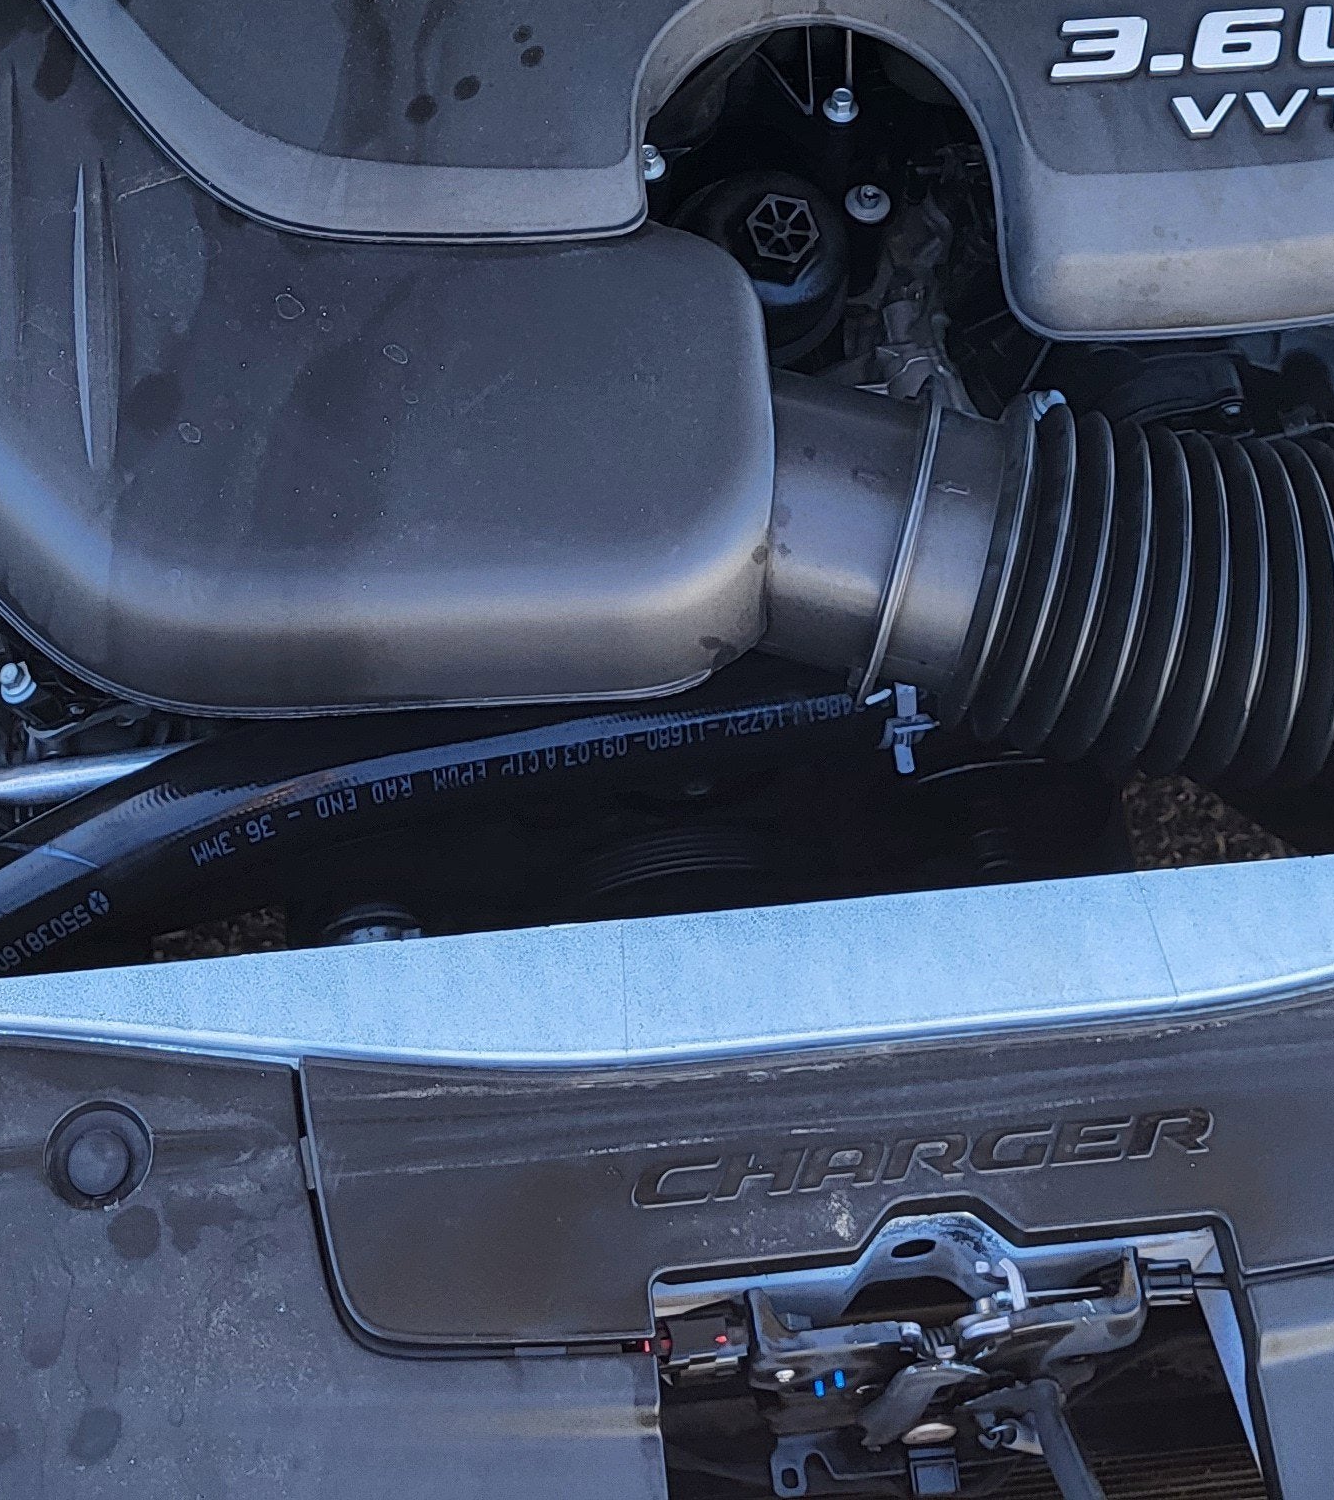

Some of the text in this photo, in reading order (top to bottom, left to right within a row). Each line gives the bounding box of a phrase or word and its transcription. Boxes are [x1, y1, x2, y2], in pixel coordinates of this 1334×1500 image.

[315, 788, 358, 819] END
[371, 774, 413, 802] RAD
[189, 815, 276, 867] 36.3MM
[631, 1107, 1215, 1209] CHARGER
